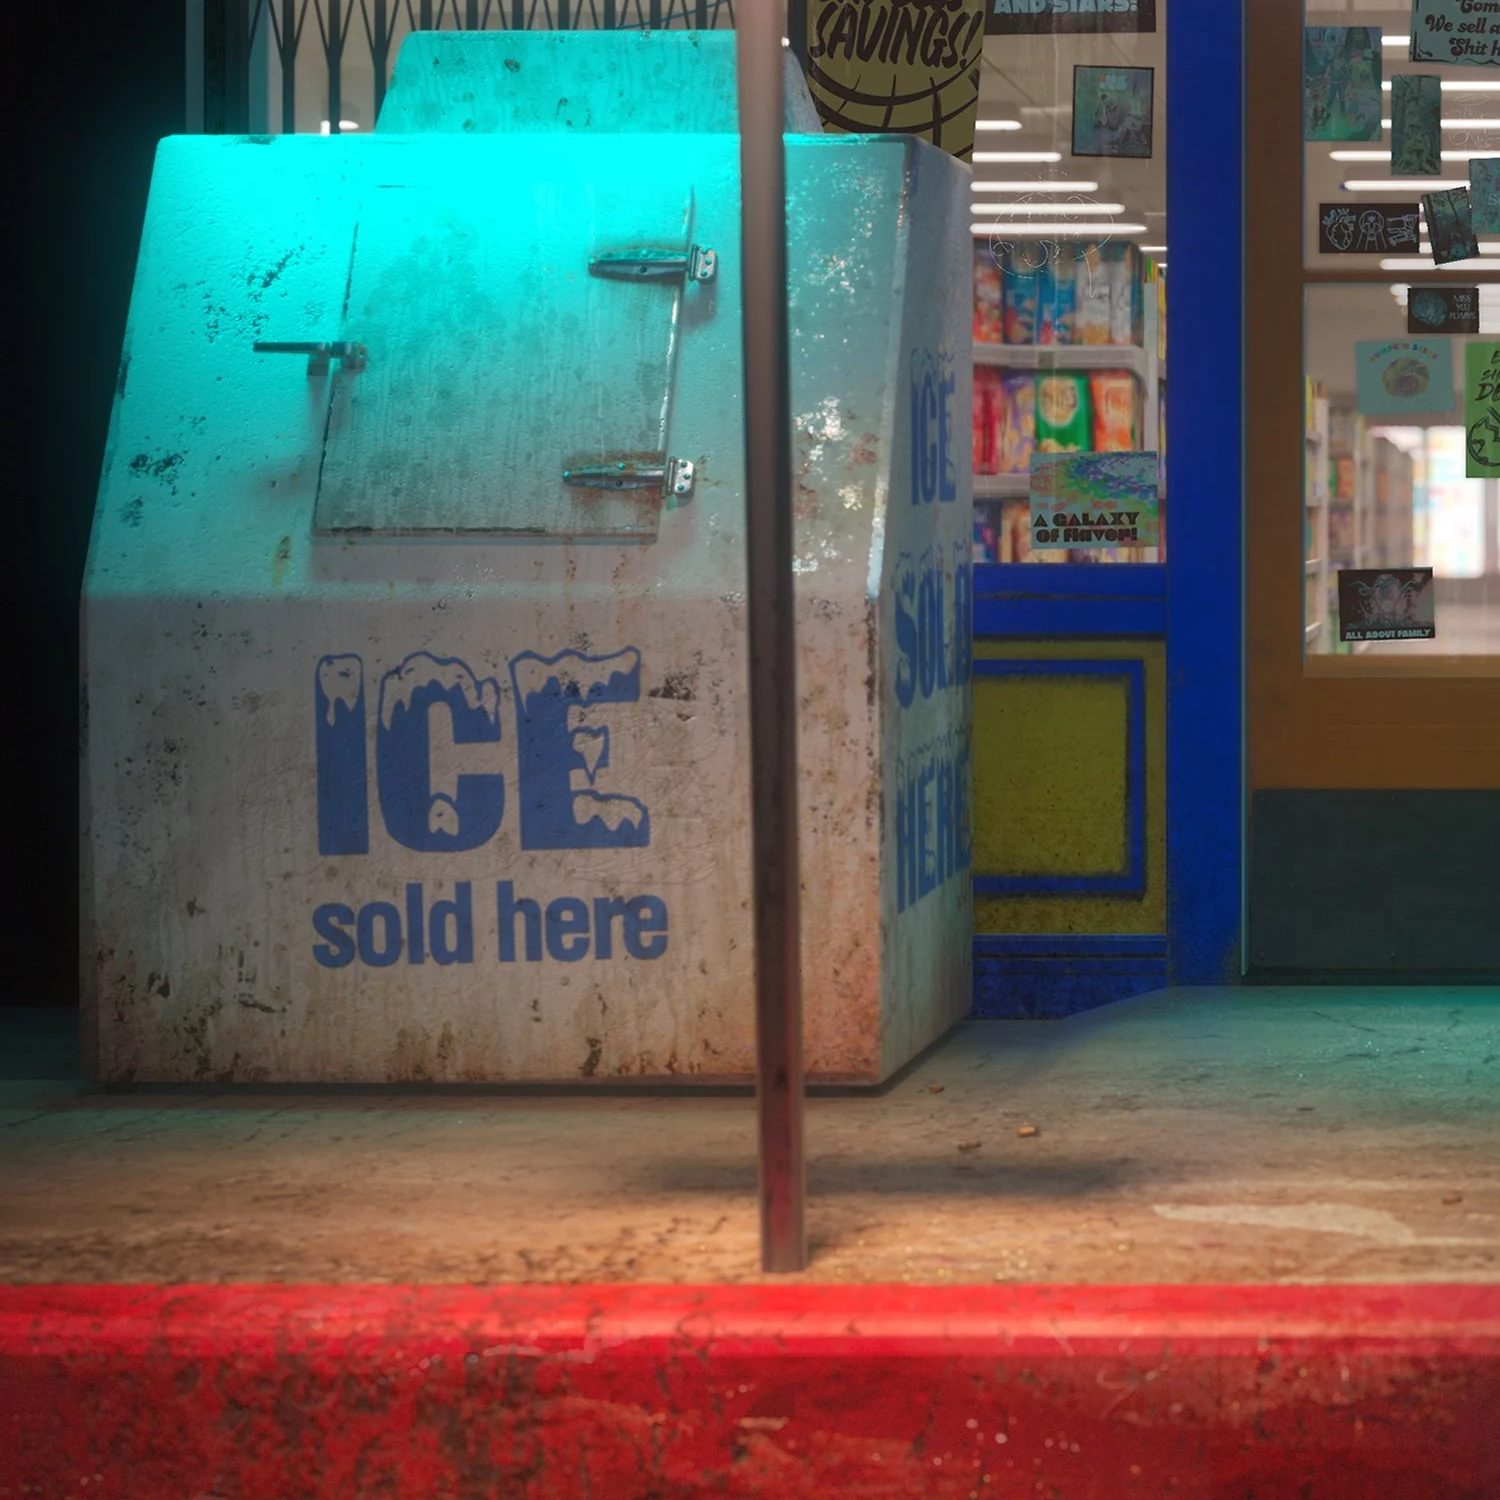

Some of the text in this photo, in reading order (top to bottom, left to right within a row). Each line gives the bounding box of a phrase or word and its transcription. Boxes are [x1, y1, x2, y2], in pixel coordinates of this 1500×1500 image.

[809, 2, 984, 69] SAVINGS!
[1425, 14, 1454, 32] We
[1457, 17, 1487, 34] sell
[1449, 37, 1488, 57] Shit
[911, 346, 956, 506] ICE
[1033, 512, 1141, 527] A GALAXY
[895, 537, 971, 709] SOLD
[1345, 629, 1432, 640] ALL ABOUT FAMILY
[315, 645, 652, 857] ICE
[897, 724, 971, 916] HERE
[313, 878, 669, 969] sold here
